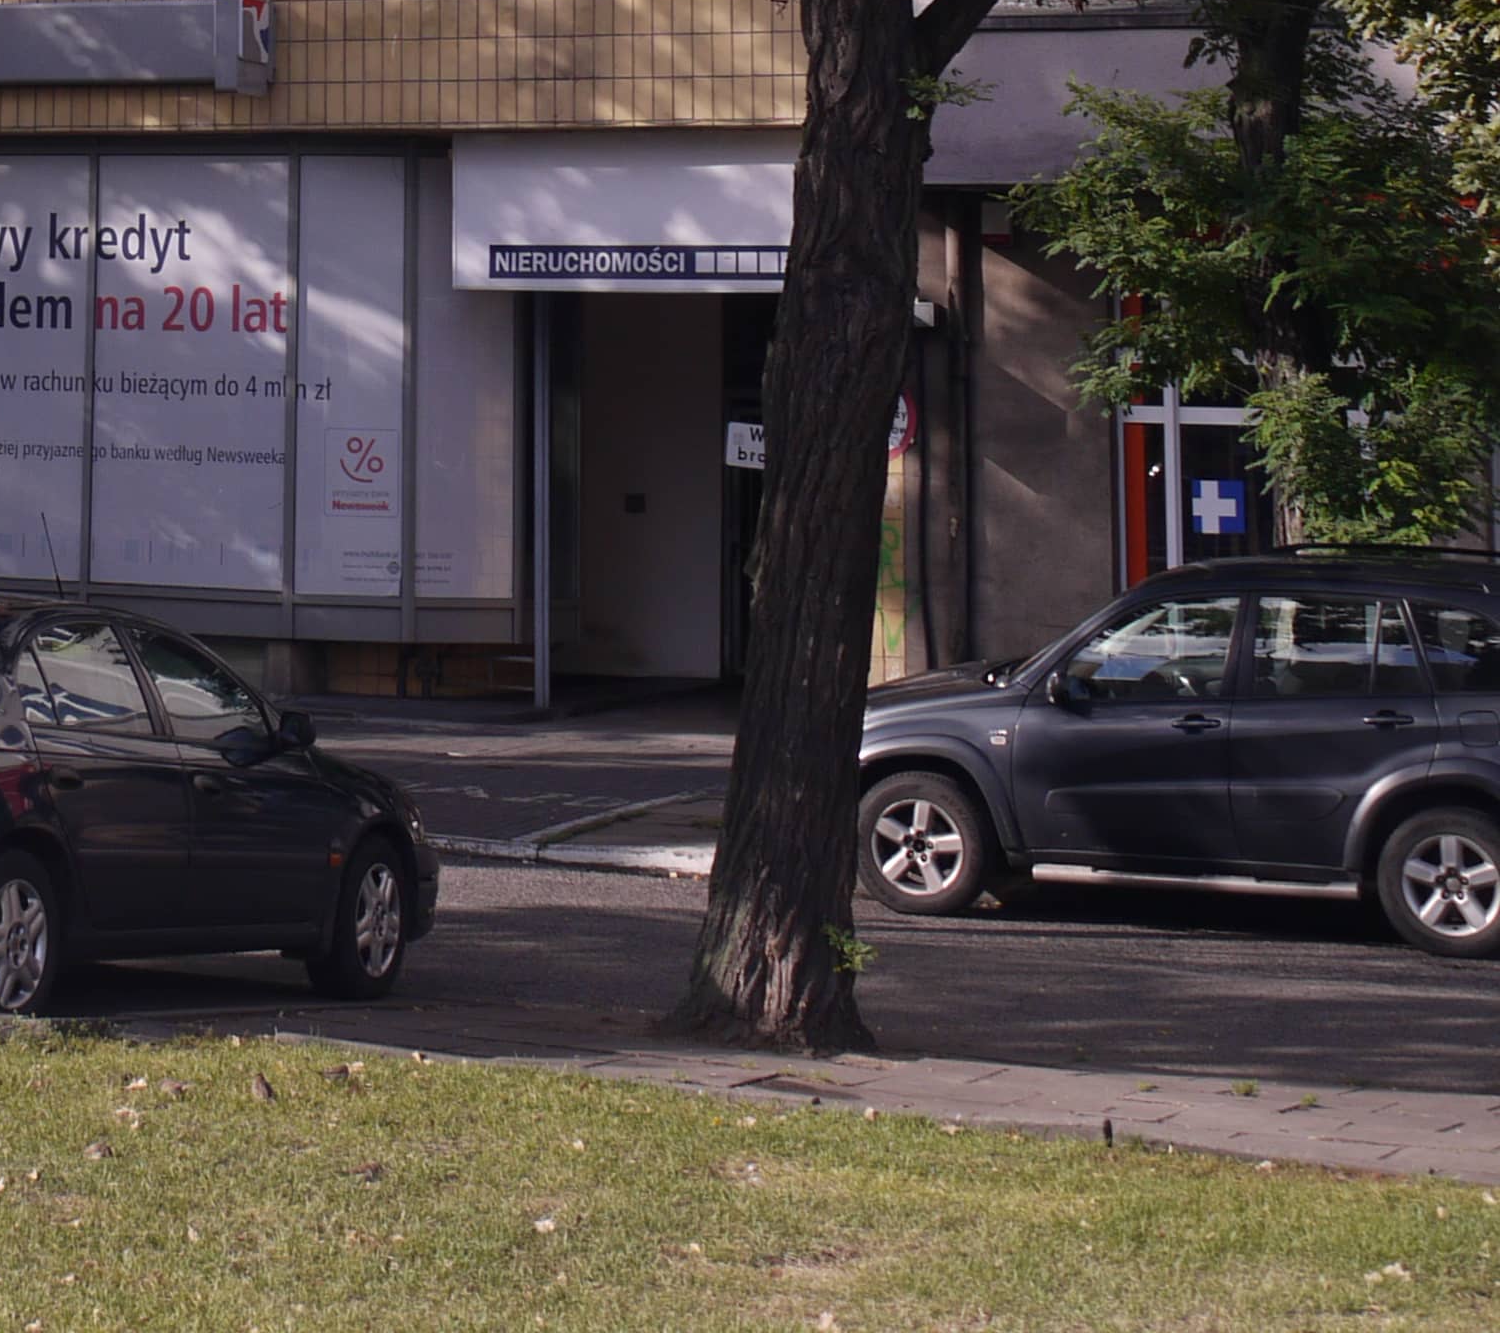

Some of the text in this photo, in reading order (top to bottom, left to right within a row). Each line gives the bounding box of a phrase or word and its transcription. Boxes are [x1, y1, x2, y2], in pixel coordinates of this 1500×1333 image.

[48, 213, 191, 274] kredyt
[495, 247, 685, 273] NIERUCHOMOŚCI
[95, 294, 146, 331] na
[162, 286, 215, 332] 20
[231, 284, 287, 333] lat
[0, 374, 17, 390] w
[23, 370, 113, 393] rachunku
[120, 371, 208, 401] bieżącym
[214, 373, 239, 397] do
[245, 376, 257, 398] 4
[314, 377, 331, 401] zł
[110, 443, 151, 461] banku
[154, 444, 202, 466] według
[206, 447, 285, 465] Newsweeka
